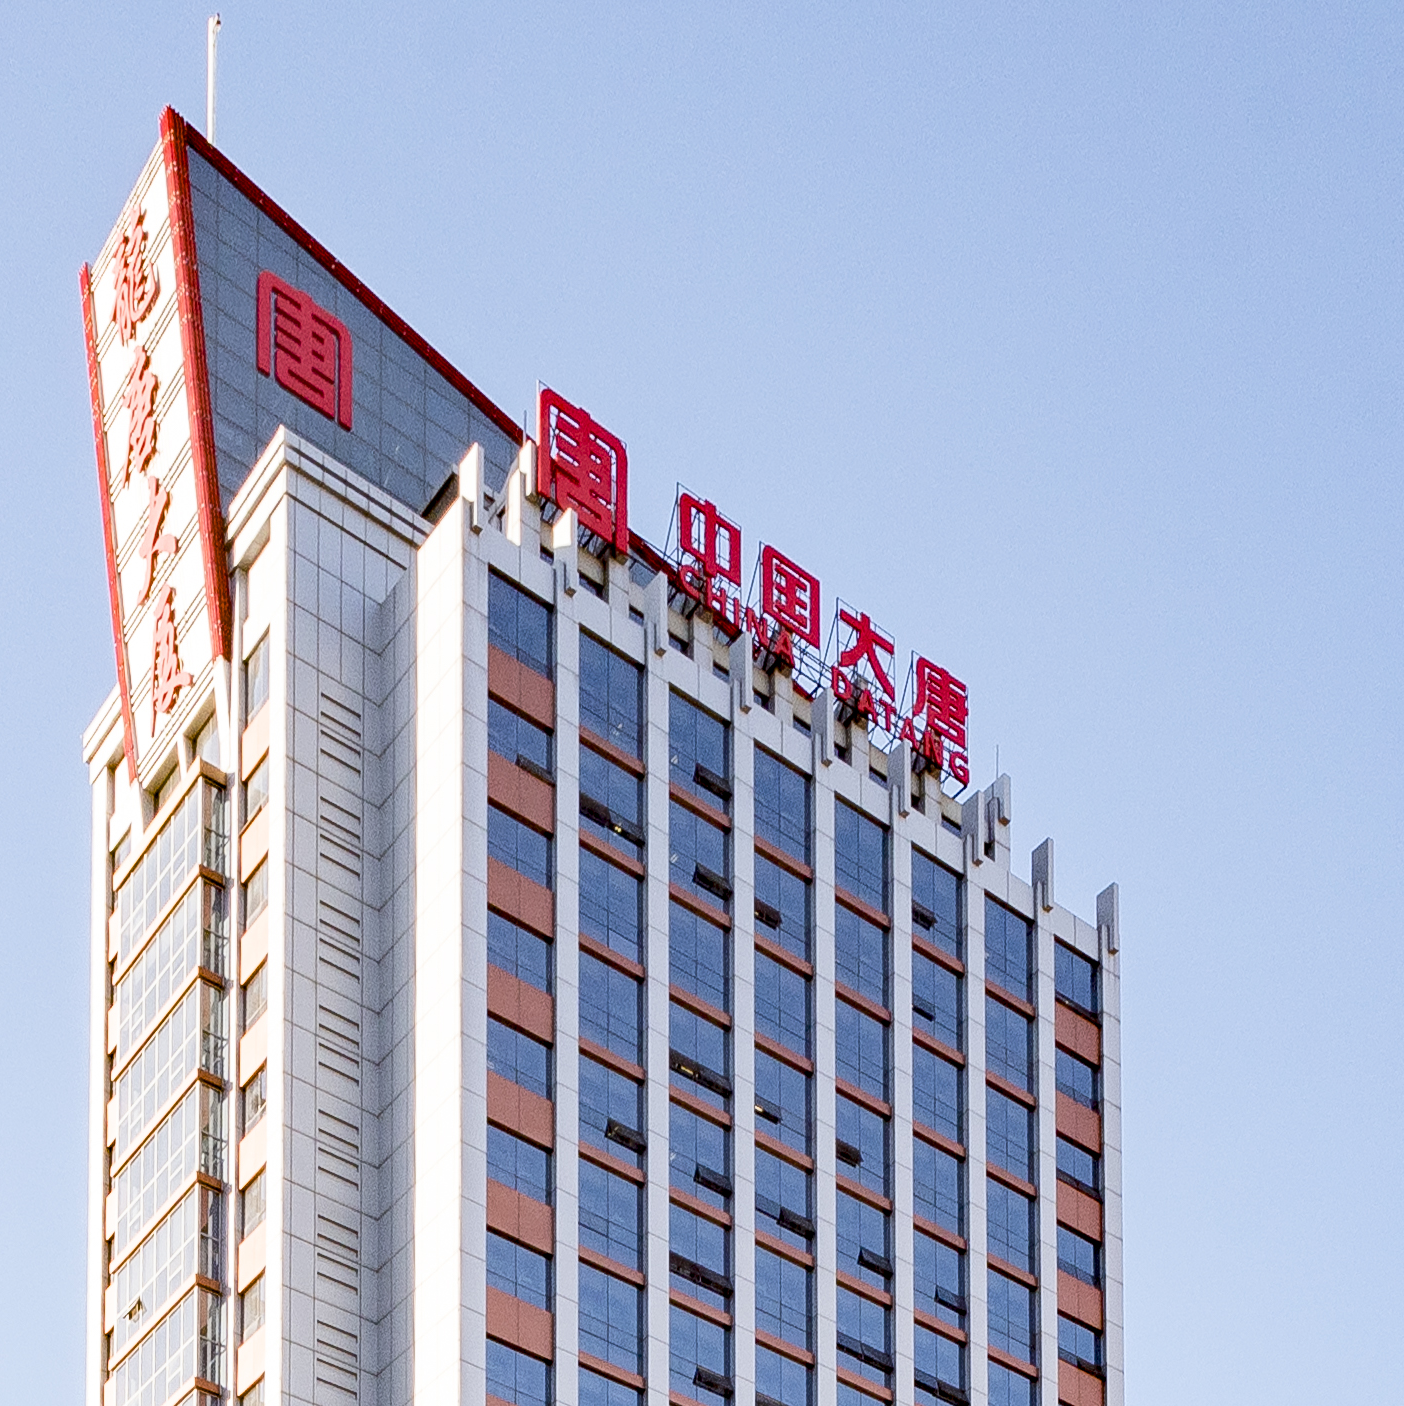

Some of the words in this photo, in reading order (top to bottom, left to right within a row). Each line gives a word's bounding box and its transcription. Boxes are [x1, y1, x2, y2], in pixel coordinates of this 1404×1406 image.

[679, 492, 970, 750] 中国大唐
[679, 564, 795, 668] CHINA
[831, 665, 970, 785] DATANG
